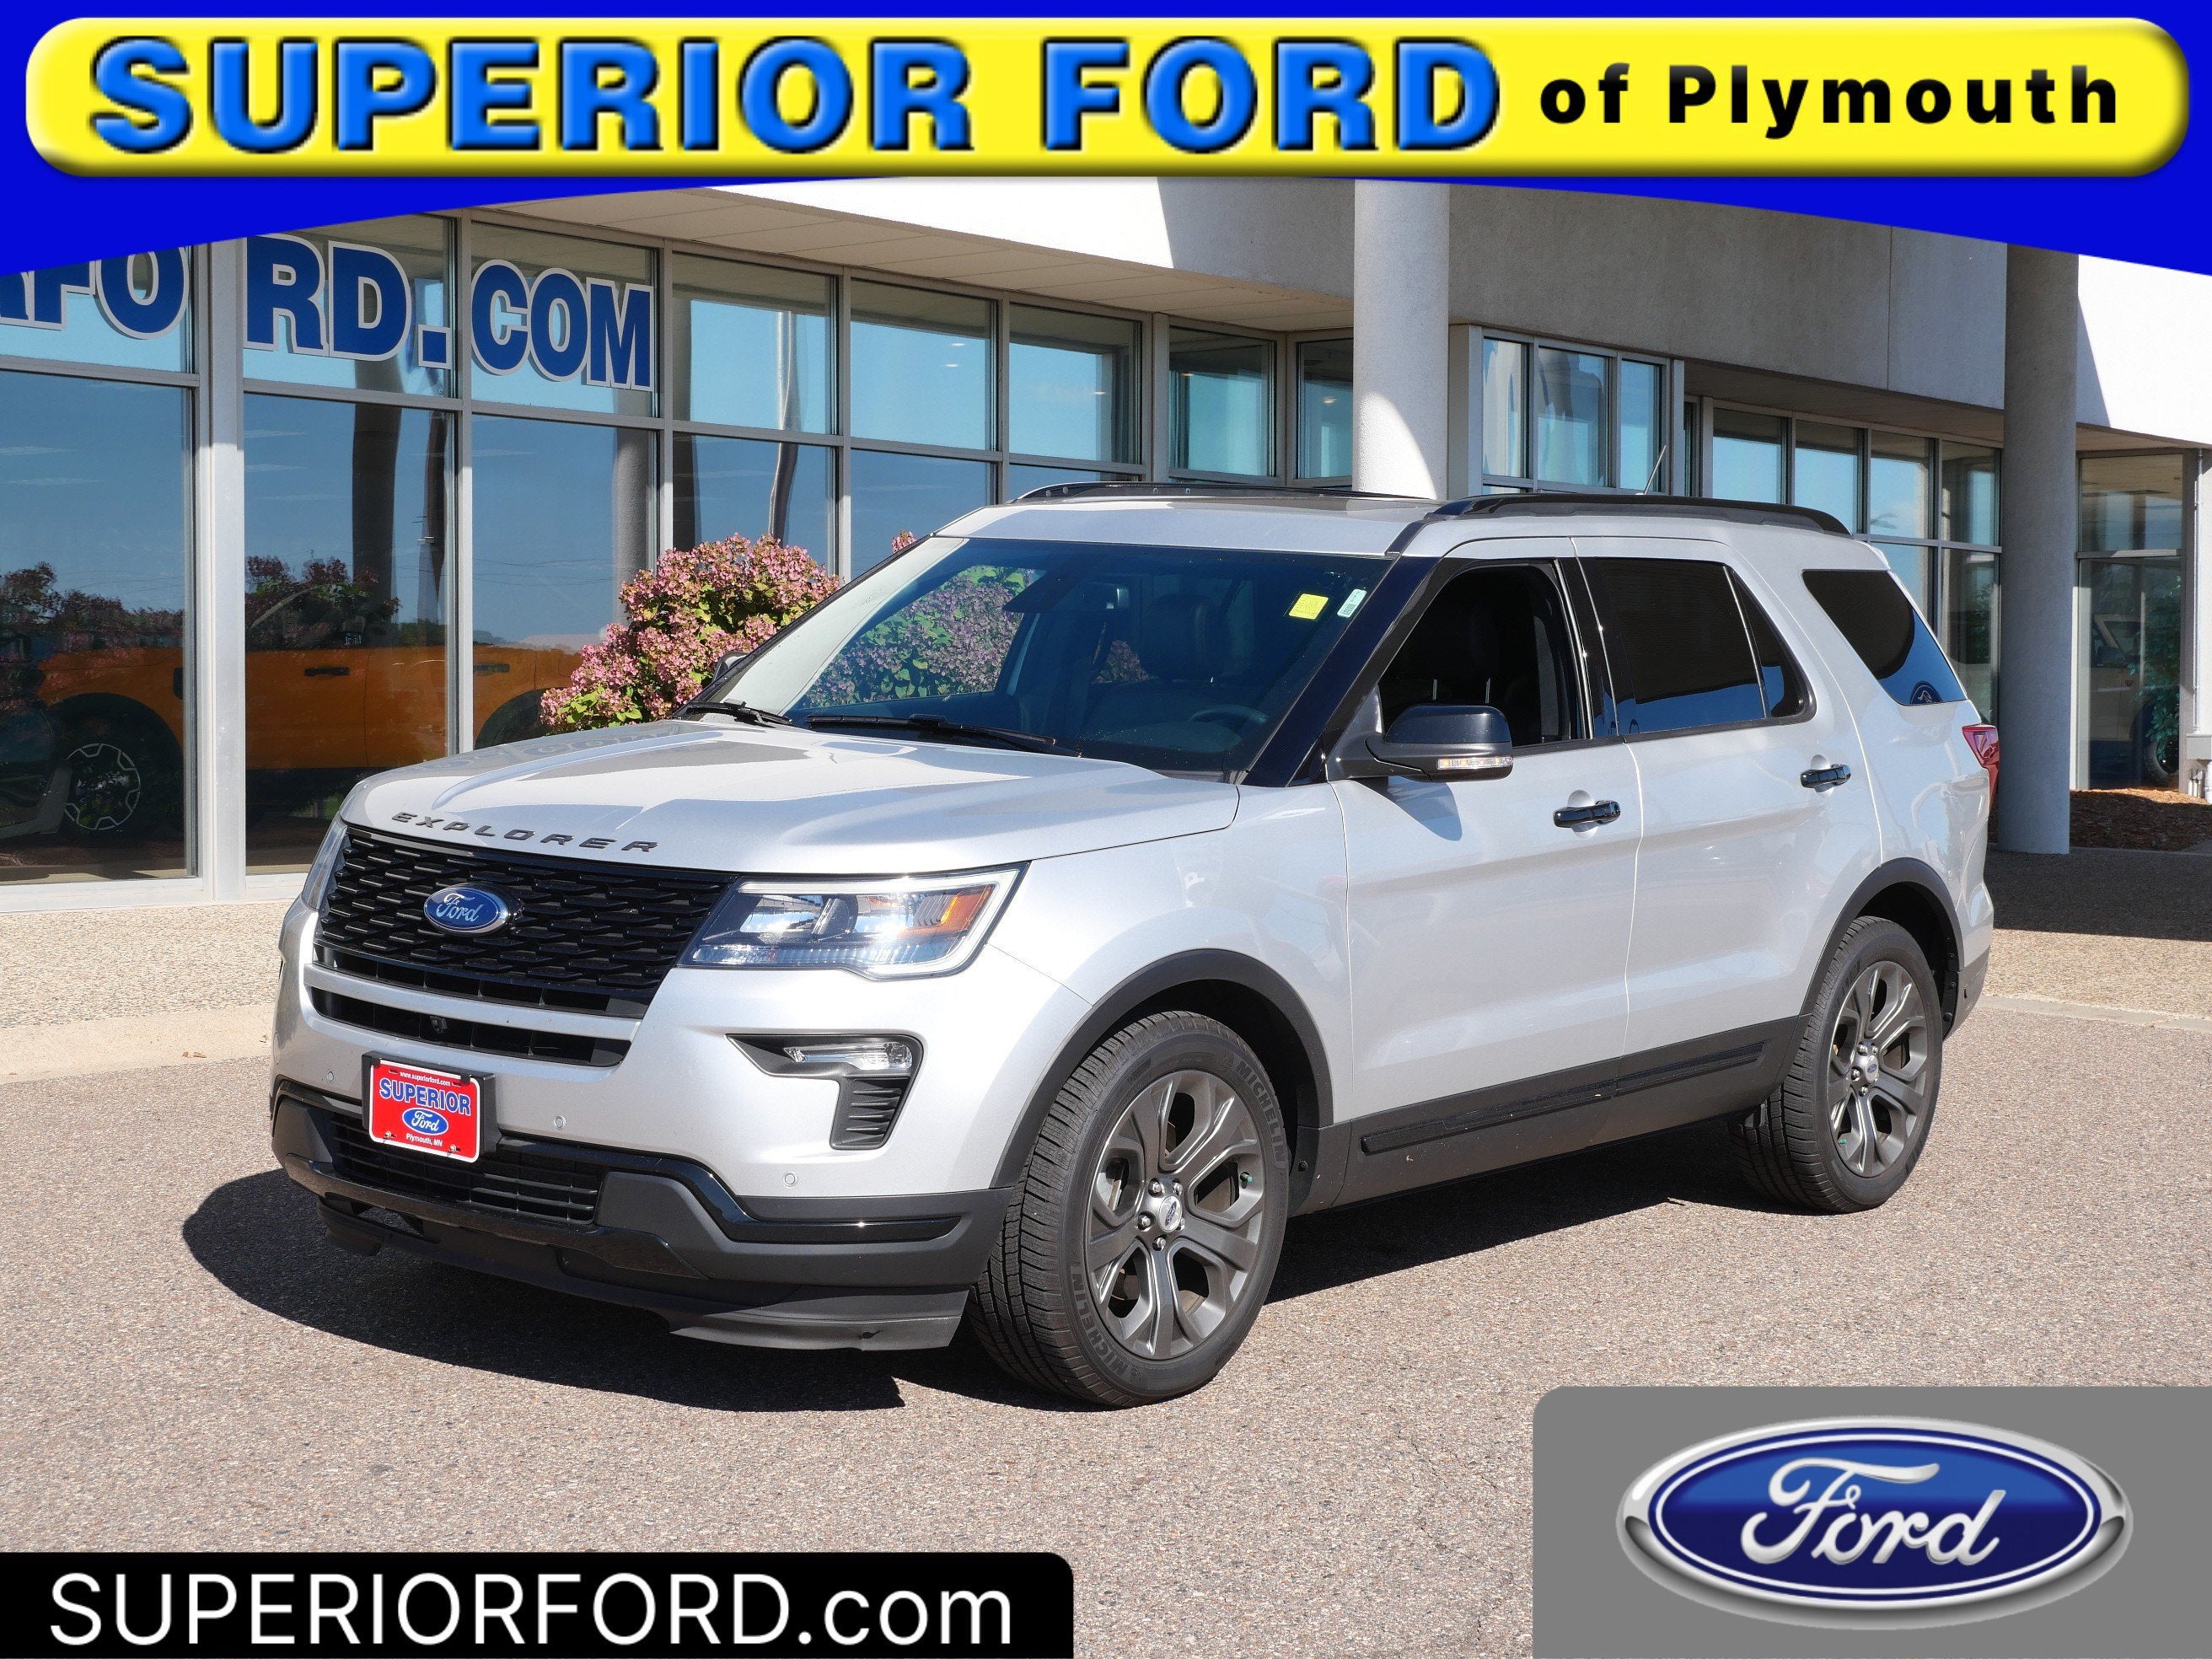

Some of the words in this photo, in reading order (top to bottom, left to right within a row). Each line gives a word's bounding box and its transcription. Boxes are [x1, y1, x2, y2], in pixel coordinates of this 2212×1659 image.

[391, 811, 660, 853] EXPLORER
[436, 893, 484, 922] Ford
[379, 1077, 472, 1117] SUPERIOR
[400, 1071, 451, 1087] www.superiorford.com
[411, 1110, 440, 1131] Ford
[1236, 1059, 1286, 1162] MICHELIN
[1072, 1273, 1130, 1377] MICHELIN
